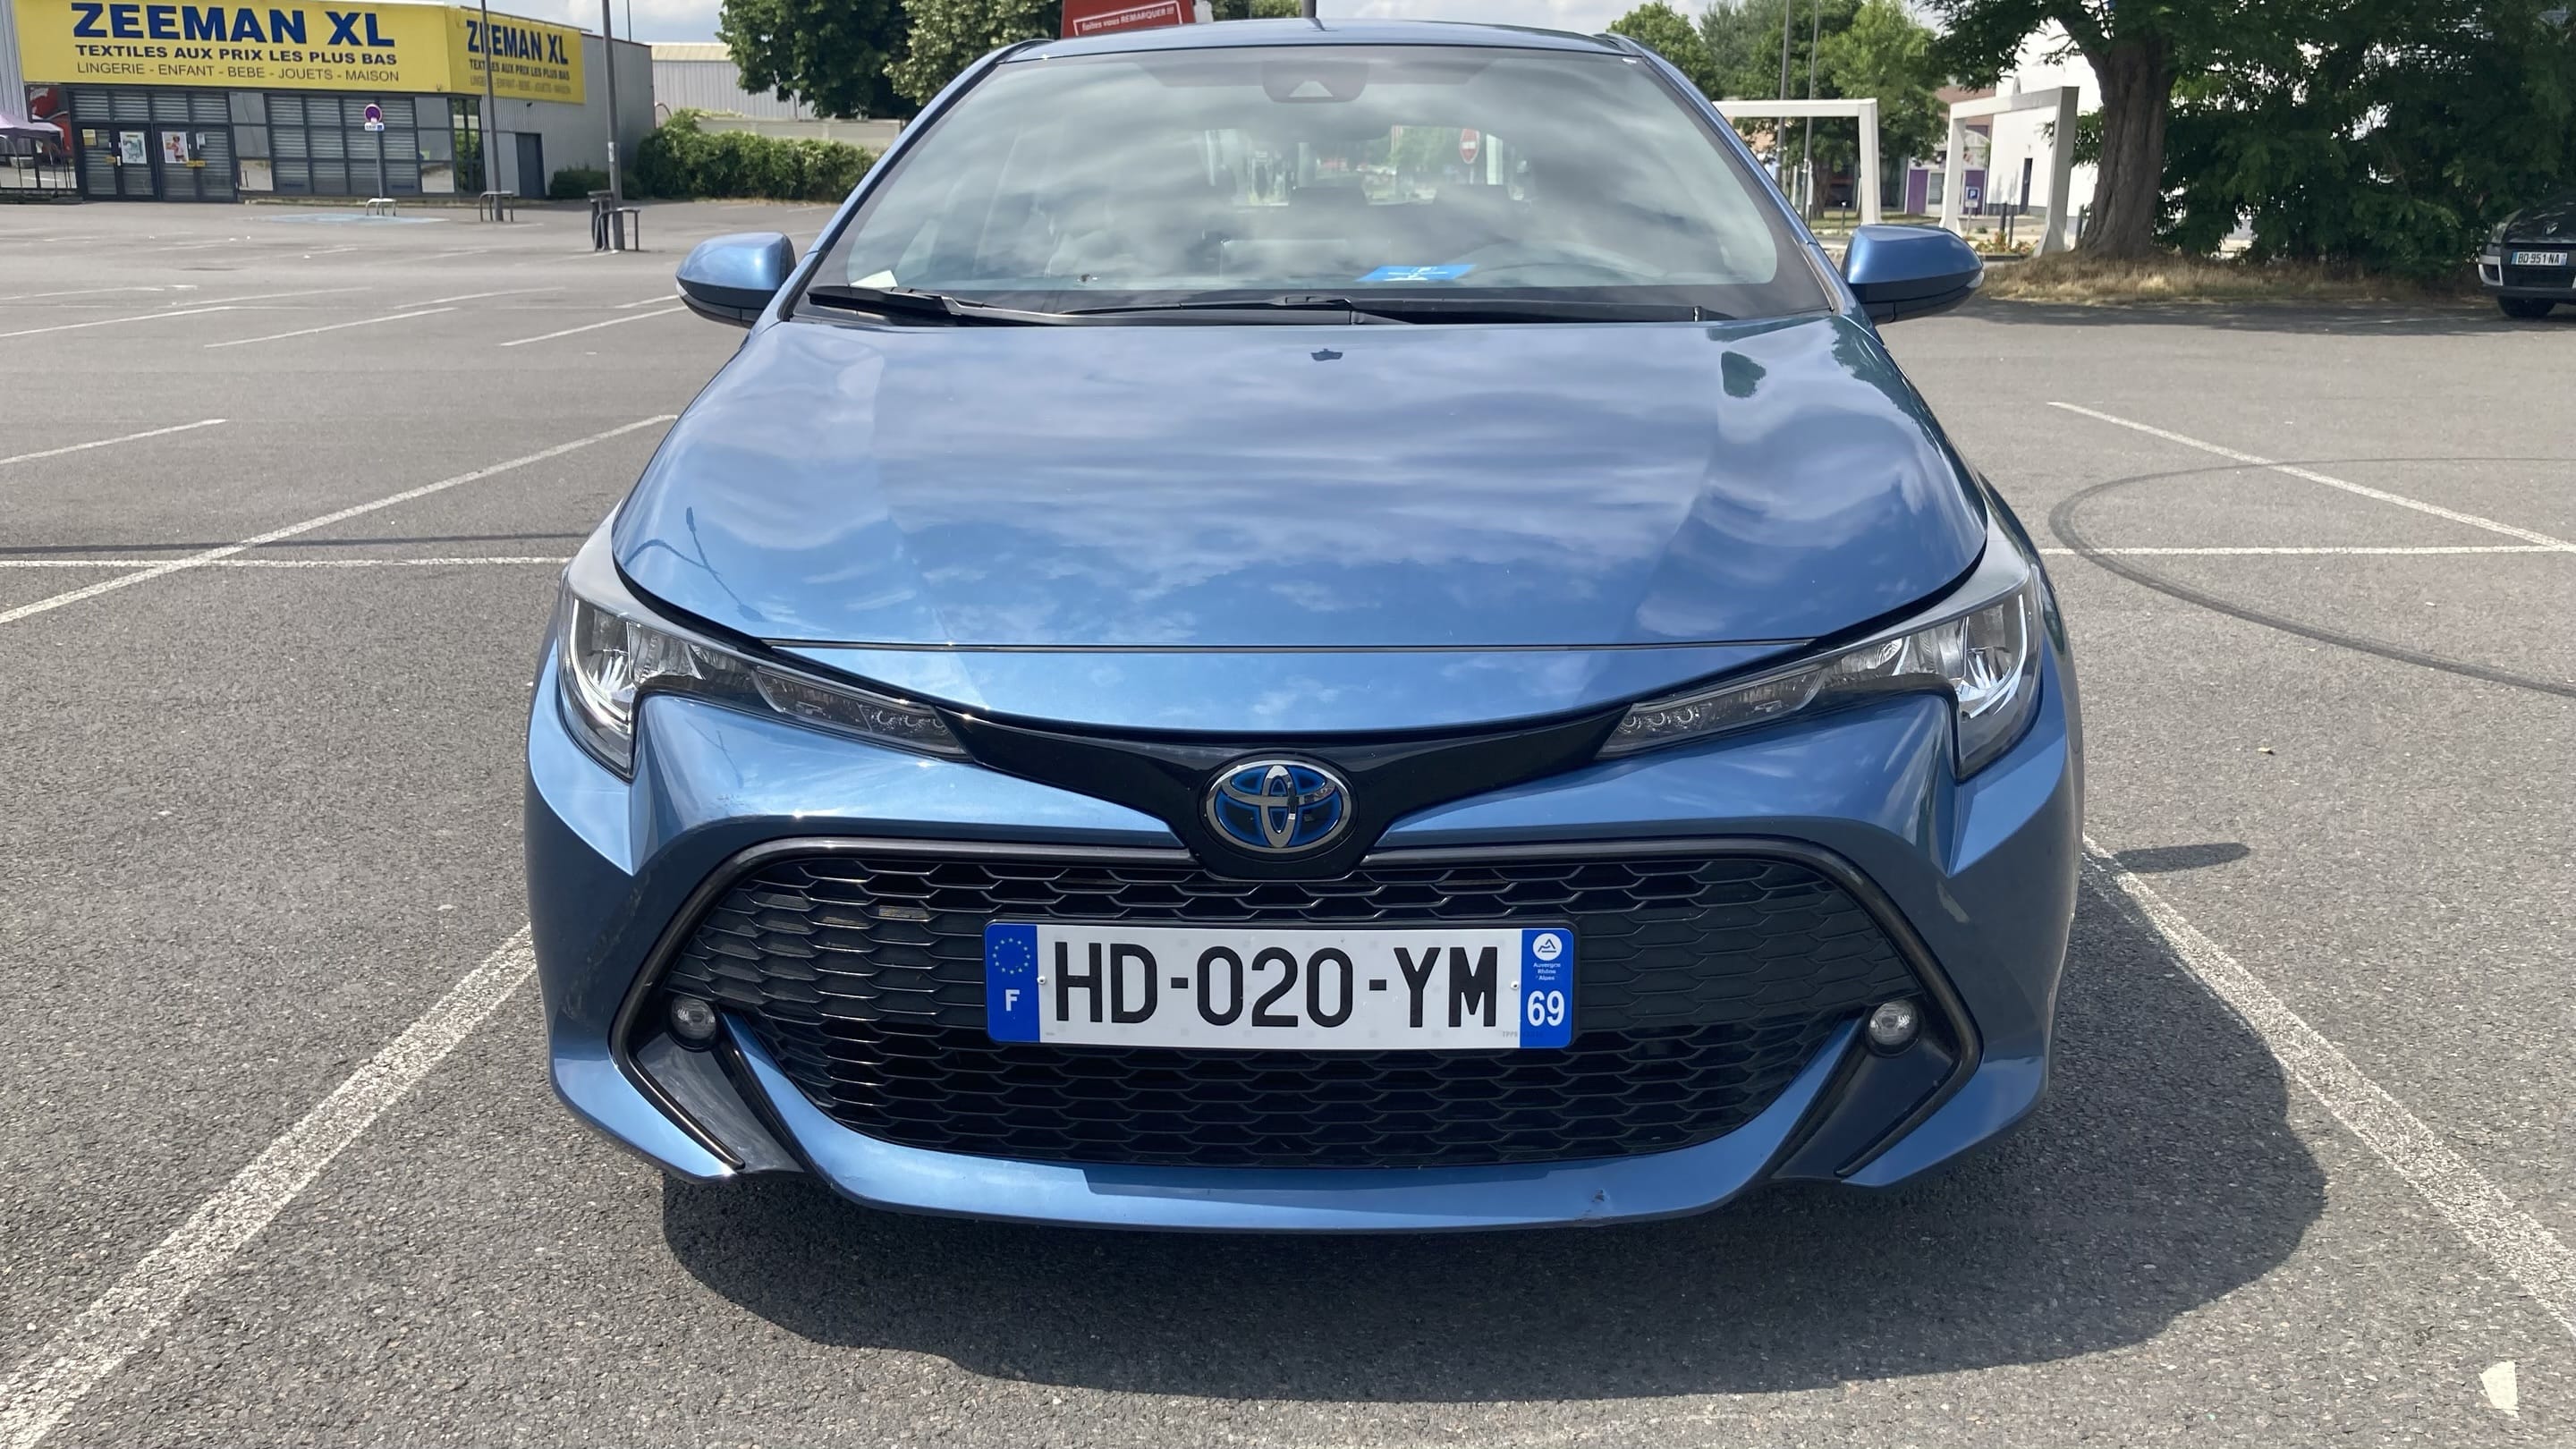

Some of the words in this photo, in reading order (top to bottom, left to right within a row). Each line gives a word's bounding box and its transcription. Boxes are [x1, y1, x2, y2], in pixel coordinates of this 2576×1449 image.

[72, 3, 307, 44] ZEEMAN
[325, 11, 395, 47] XL
[1121, 7, 1165, 23] REMARQUER
[75, 45, 167, 58] TEXTILES
[174, 47, 213, 59] AUX
[219, 48, 263, 61] PRIX
[269, 50, 302, 62] LES
[309, 51, 356, 64] PLUS
[361, 53, 397, 65] BAS
[547, 33, 569, 64] XL
[77, 62, 145, 74] LINGERIE
[158, 64, 215, 77] ENFANT
[228, 66, 265, 78] BEBE
[278, 68, 334, 80] JOUETS
[345, 70, 399, 81] MAISON
[470, 58, 499, 72] TEXTES
[1055, 942, 1497, 1029] HD-020-YM
[1005, 989, 1020, 1012] F
[1528, 990, 1564, 1026] 69
